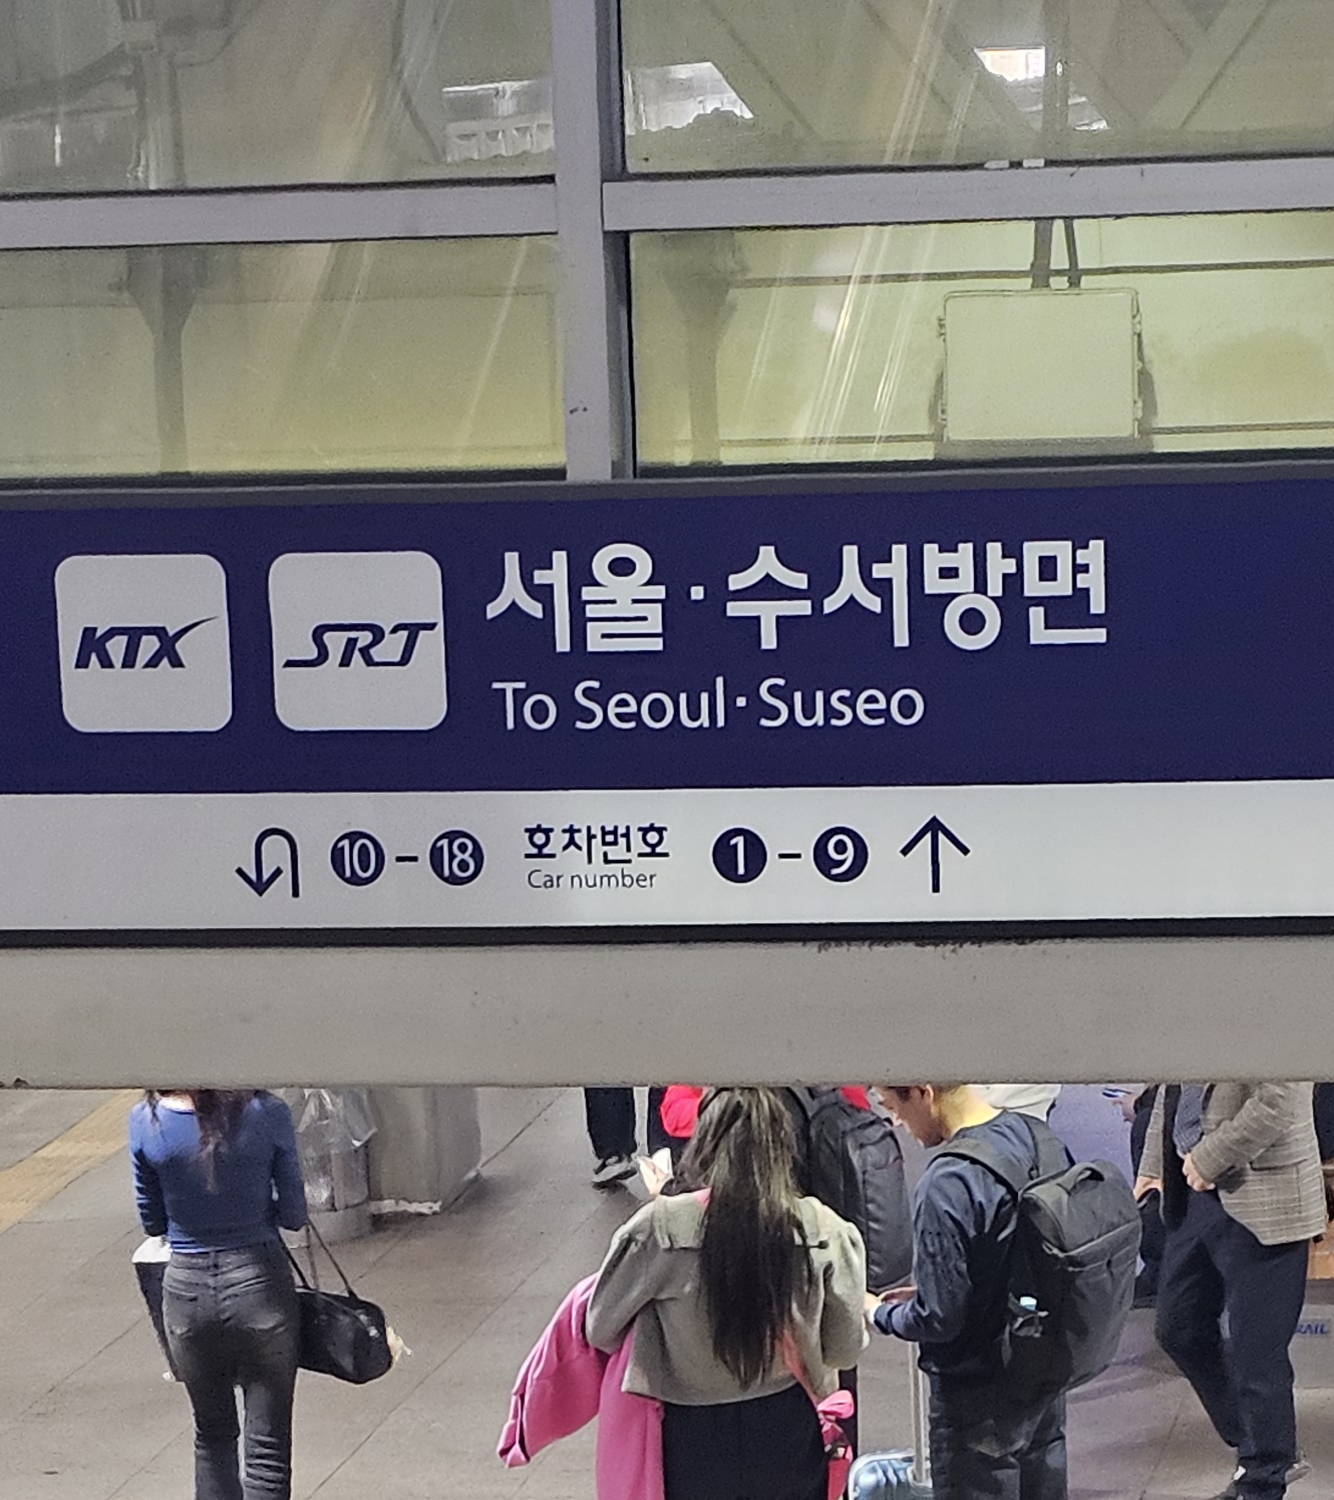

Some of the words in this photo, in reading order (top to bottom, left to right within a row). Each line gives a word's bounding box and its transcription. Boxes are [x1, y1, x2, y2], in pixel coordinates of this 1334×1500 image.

[74, 617, 220, 670] KTX
[282, 621, 438, 669] SRT
[492, 681, 557, 731] To
[524, 823, 670, 865] 호차번호
[527, 869, 564, 890] Car
[570, 867, 657, 890] number
